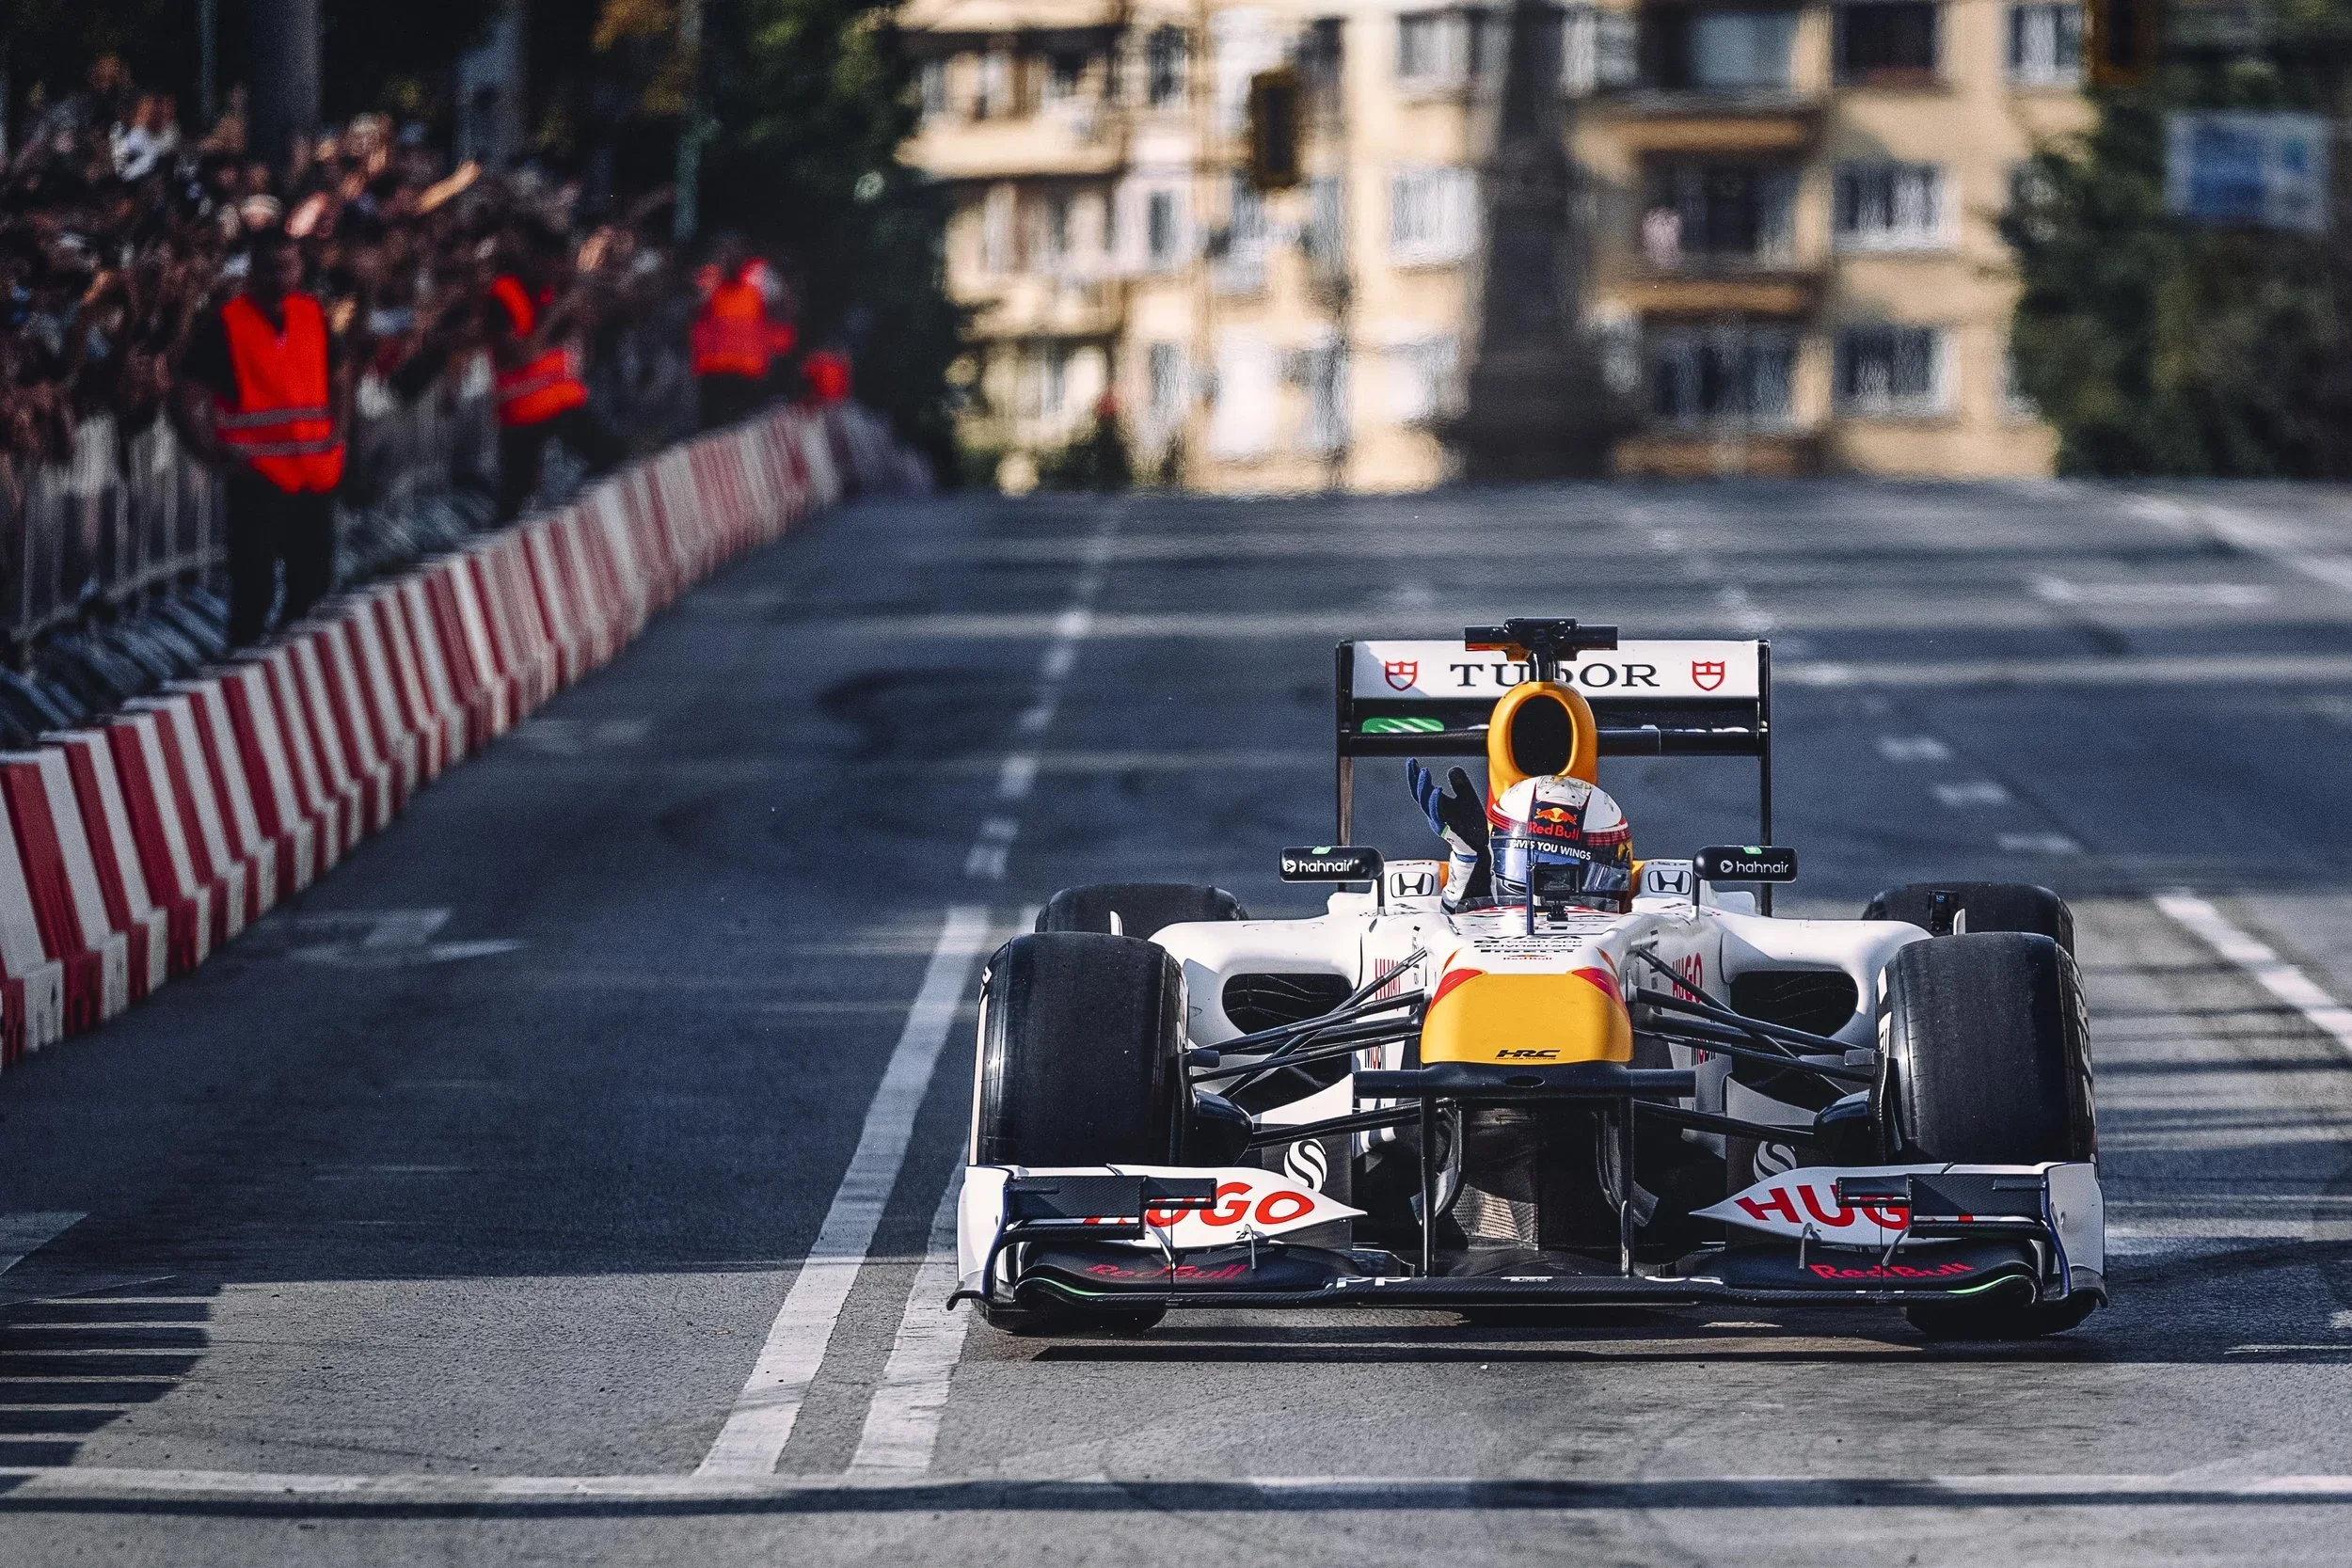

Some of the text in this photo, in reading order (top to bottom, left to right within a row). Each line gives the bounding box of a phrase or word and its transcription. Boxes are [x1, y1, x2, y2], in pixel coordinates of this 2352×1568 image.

[1528, 822, 1581, 841] Red Bull
[1537, 842, 1559, 853] YOU
[1560, 847, 1592, 861] WINGS
[1299, 860, 1352, 873] hahnair
[1736, 861, 1789, 874] hahnair
[1496, 1049, 1561, 1058] HRC
[1734, 1185, 1910, 1230] HUG
